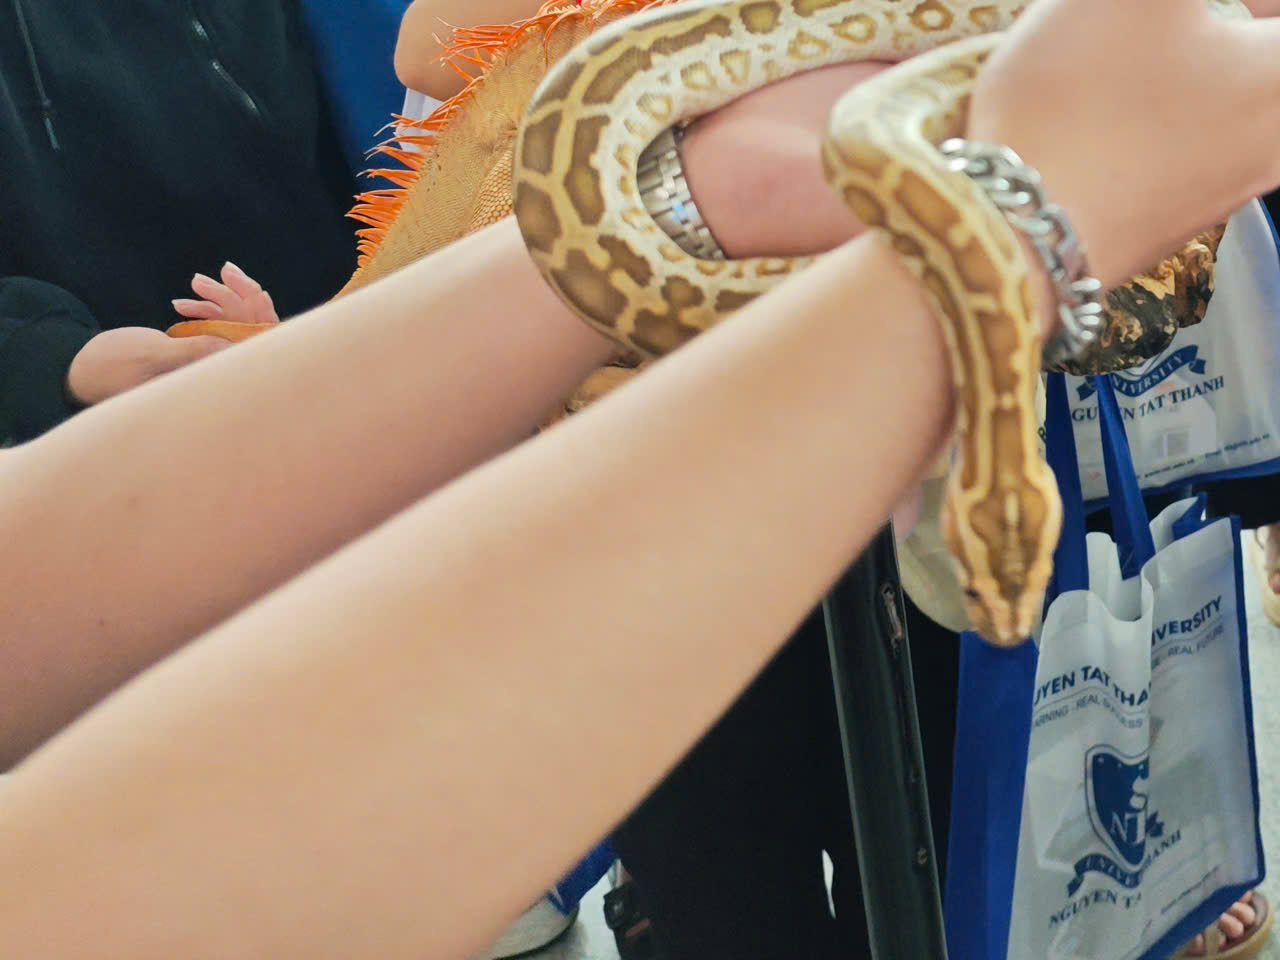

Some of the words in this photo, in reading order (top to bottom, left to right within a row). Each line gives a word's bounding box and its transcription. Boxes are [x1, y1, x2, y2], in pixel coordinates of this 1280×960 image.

[1112, 352, 1184, 394] NIVERSITY
[1138, 394, 1167, 417] TAT
[1168, 375, 1225, 405] THANH
[1080, 665, 1110, 687] TAT
[1113, 681, 1152, 707] THA
